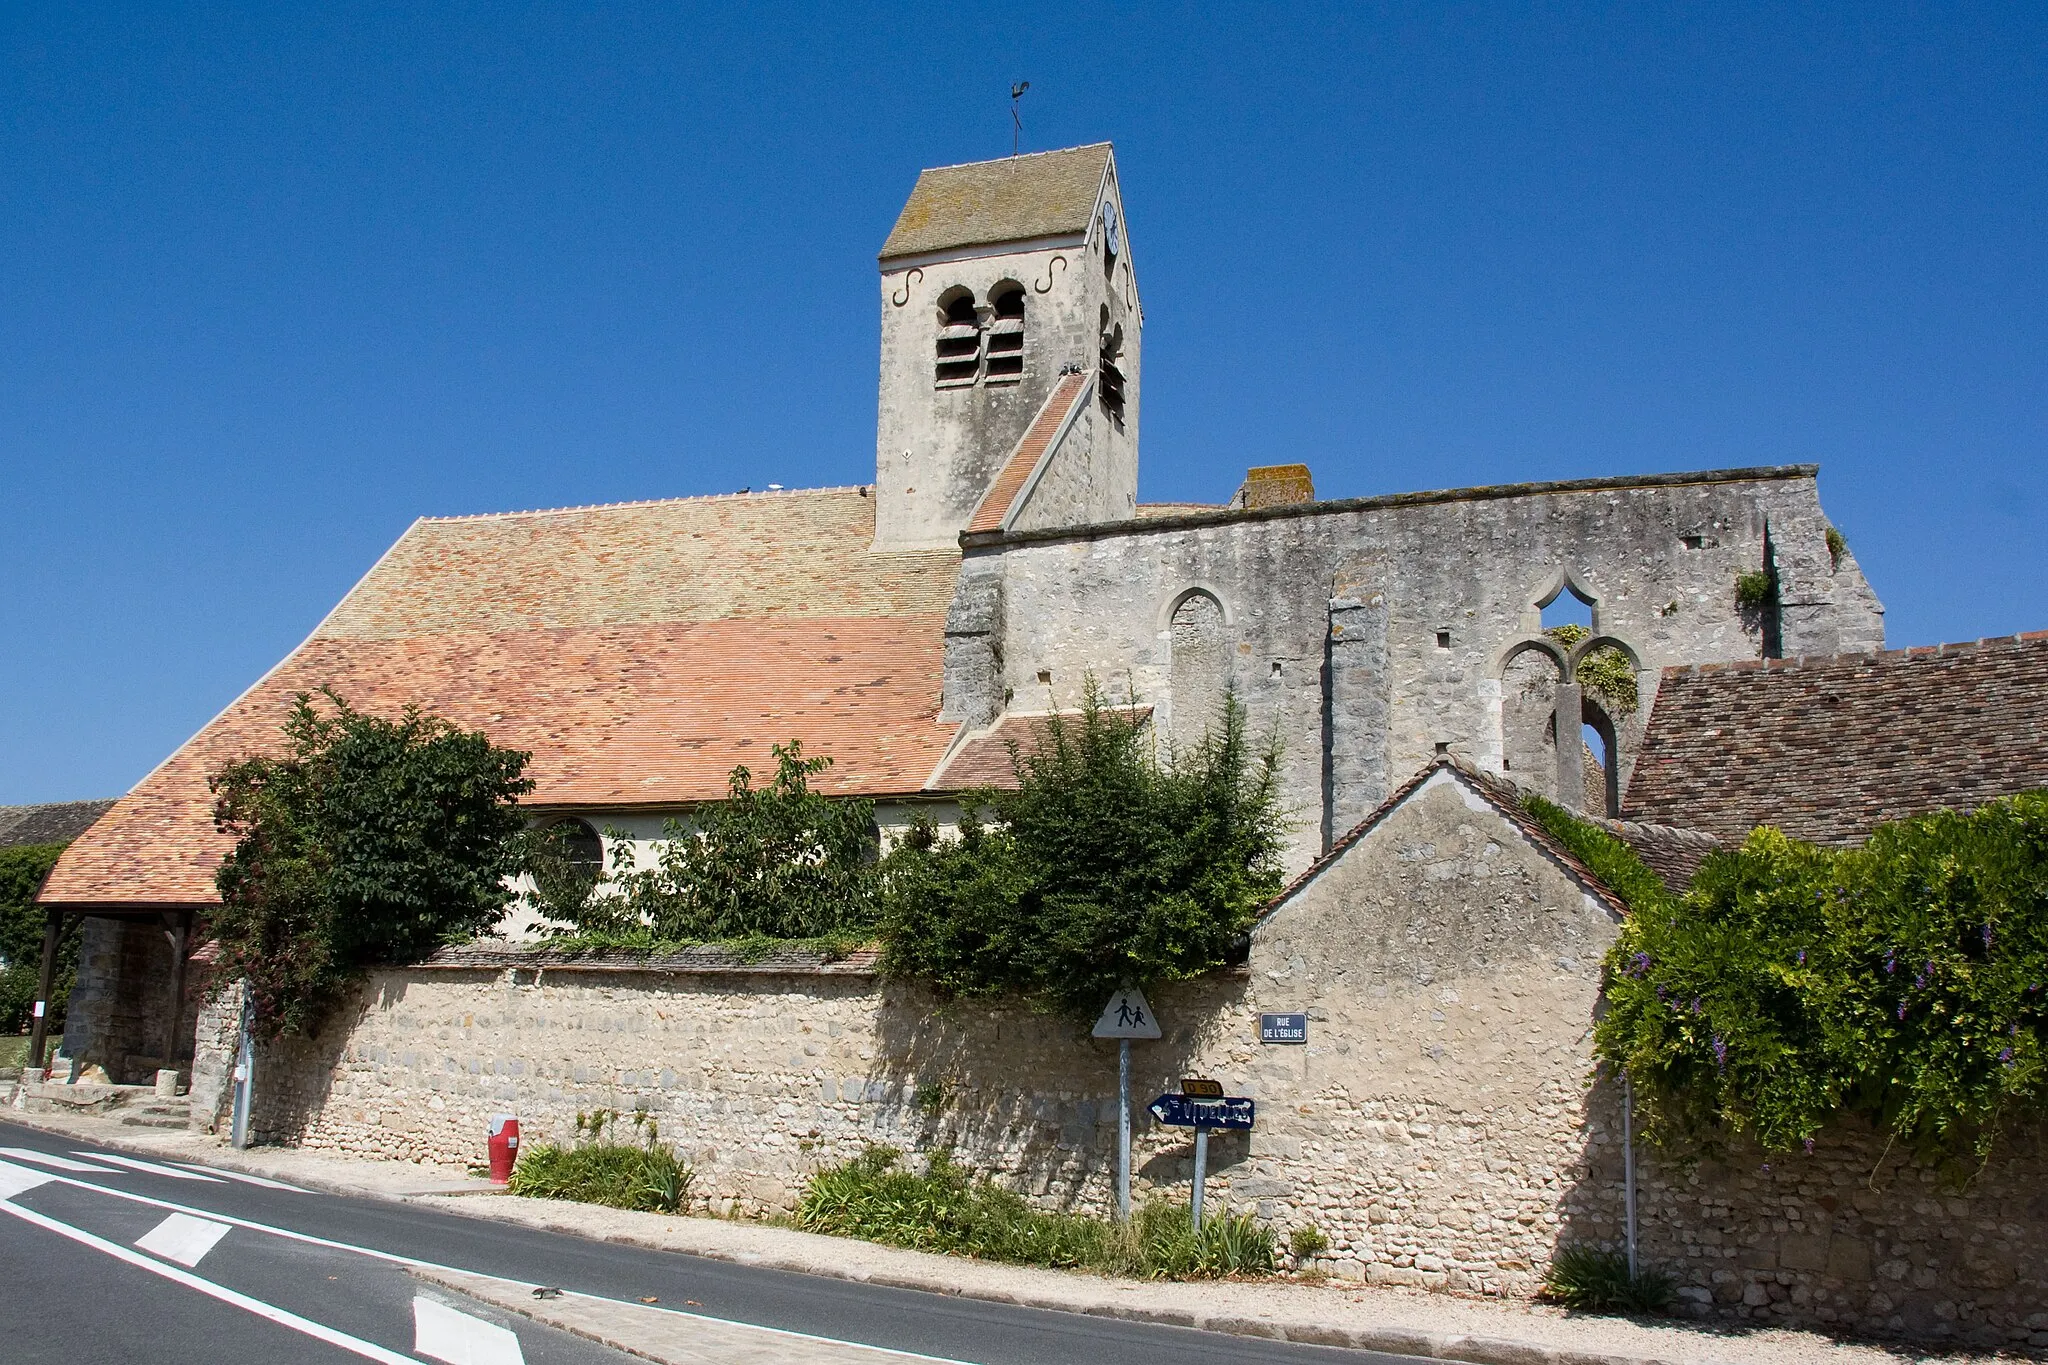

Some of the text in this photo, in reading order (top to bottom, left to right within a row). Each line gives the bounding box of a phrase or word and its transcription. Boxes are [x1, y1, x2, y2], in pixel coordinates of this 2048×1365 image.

[1276, 1017, 1290, 1027] RUE
[1263, 1027, 1303, 1038] DE L'ÉGLISE
[1187, 1083, 1217, 1094] D 90
[1183, 1101, 1248, 1120] VIDELLES
